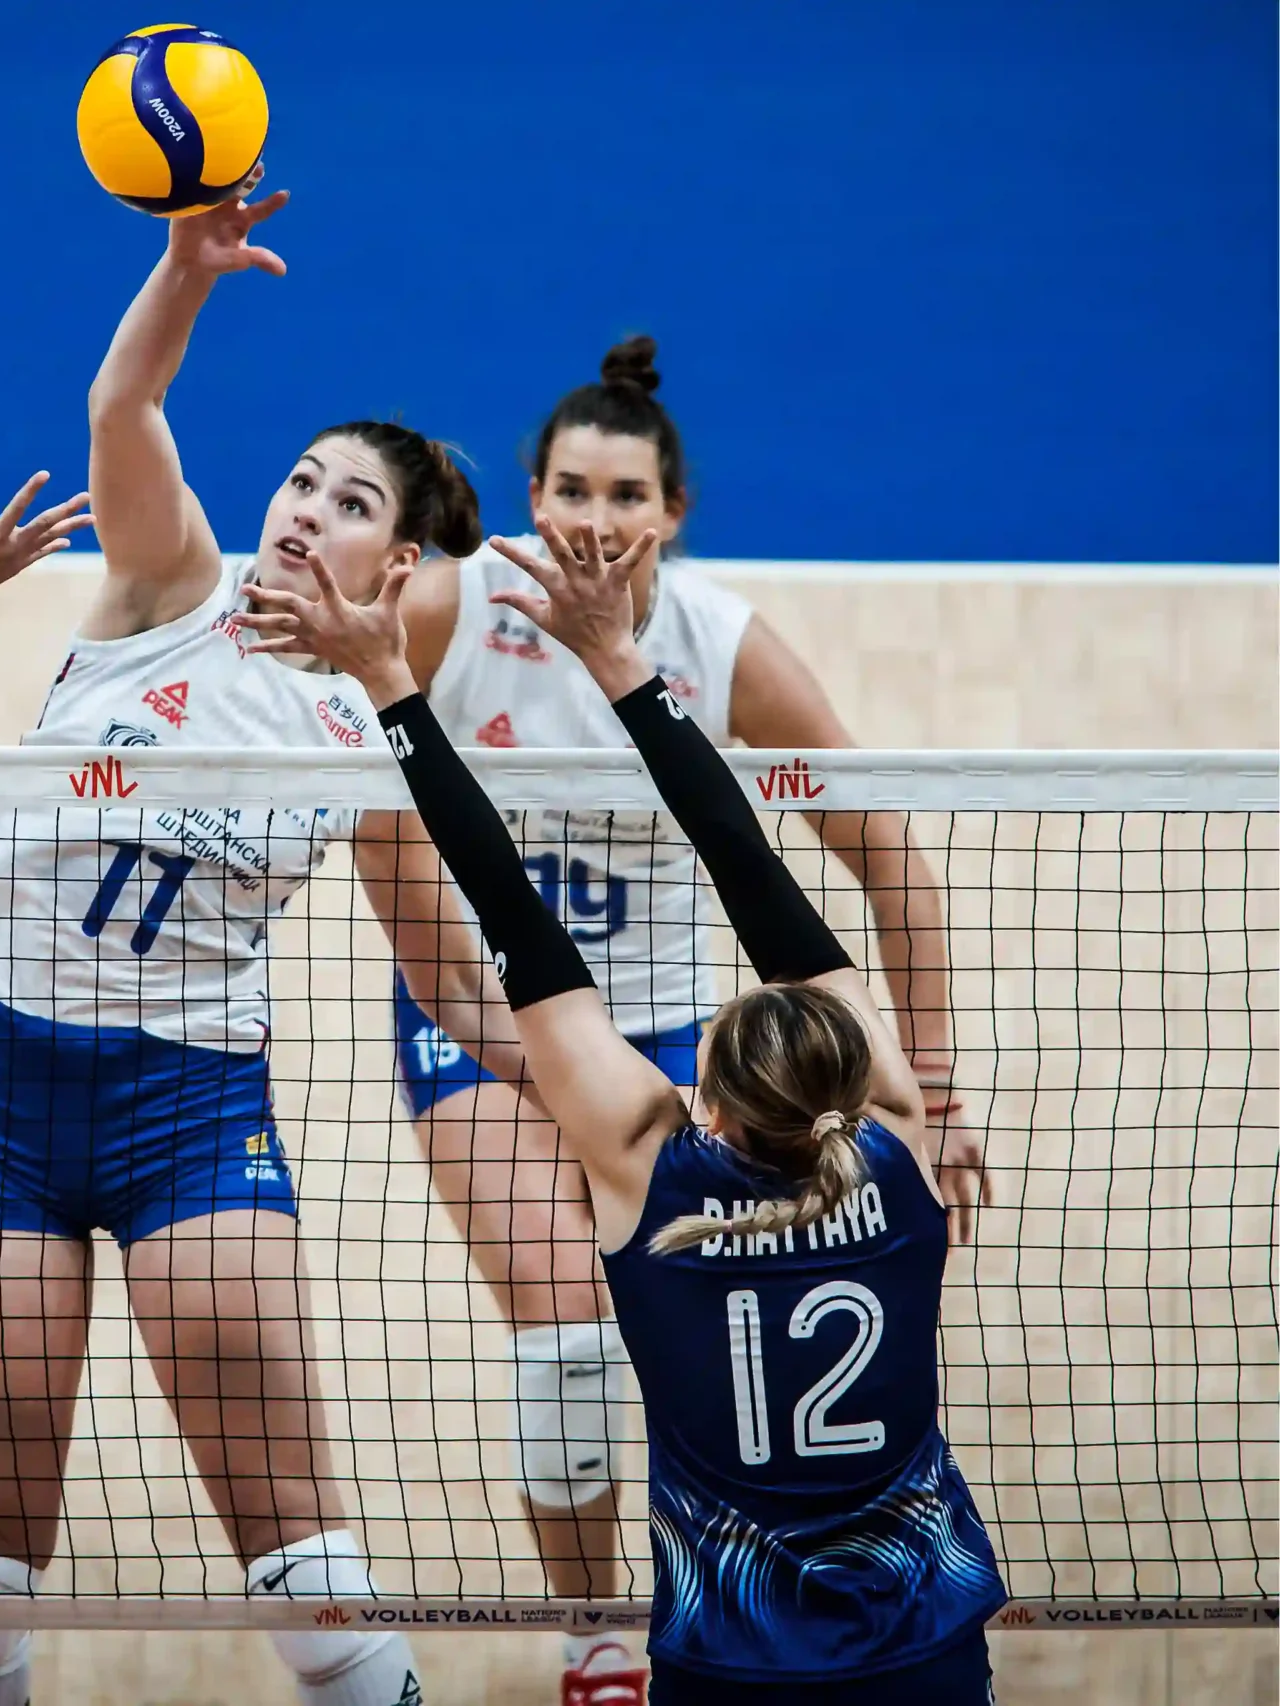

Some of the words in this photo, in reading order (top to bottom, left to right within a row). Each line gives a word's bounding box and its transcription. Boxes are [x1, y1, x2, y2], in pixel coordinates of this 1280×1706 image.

[149, 97, 186, 142] V200W
[141, 688, 190, 731] PEAK
[316, 700, 366, 748] Gante
[328, 694, 368, 733] 百岁山
[656, 688, 689, 721] 2
[385, 723, 415, 761] 12
[755, 757, 826, 801] VNL
[177, 808, 272, 876] ОШТАНСКА
[80, 839, 196, 956] 17
[523, 852, 628, 943] 19
[726, 1280, 886, 1466] 12
[360, 1609, 517, 1625] VOLLEYBALL
[1046, 1608, 1199, 1623] VOLLEYBALL
